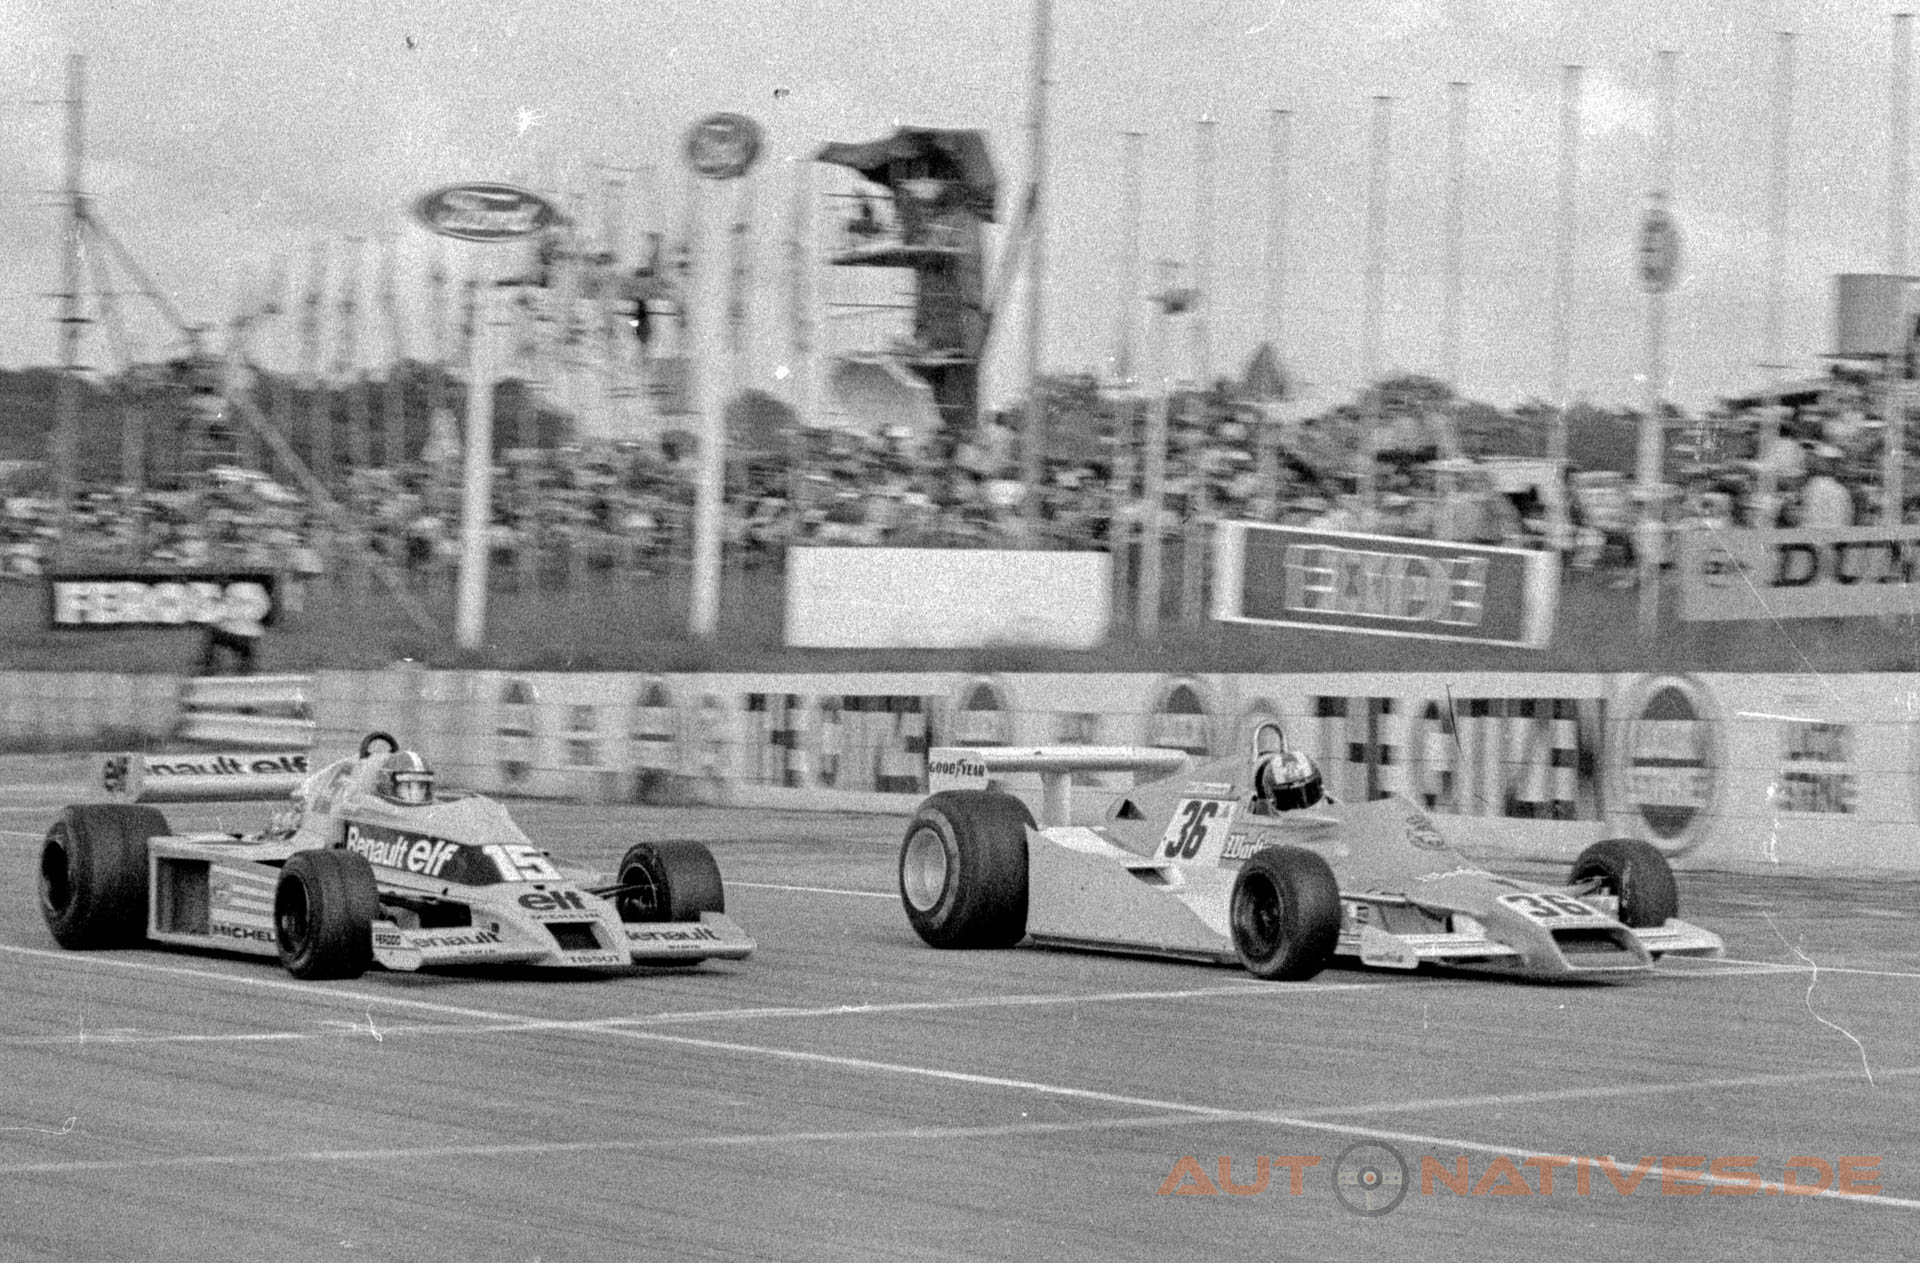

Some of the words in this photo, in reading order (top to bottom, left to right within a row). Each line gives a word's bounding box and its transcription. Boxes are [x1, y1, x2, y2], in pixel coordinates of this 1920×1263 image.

[929, 759, 985, 778] GOODYEAR
[1165, 800, 1219, 859] 36
[346, 825, 408, 869] Renault
[407, 839, 461, 877] elf
[482, 844, 563, 882] 15
[518, 891, 586, 911] elf
[1504, 893, 1594, 918] 36
